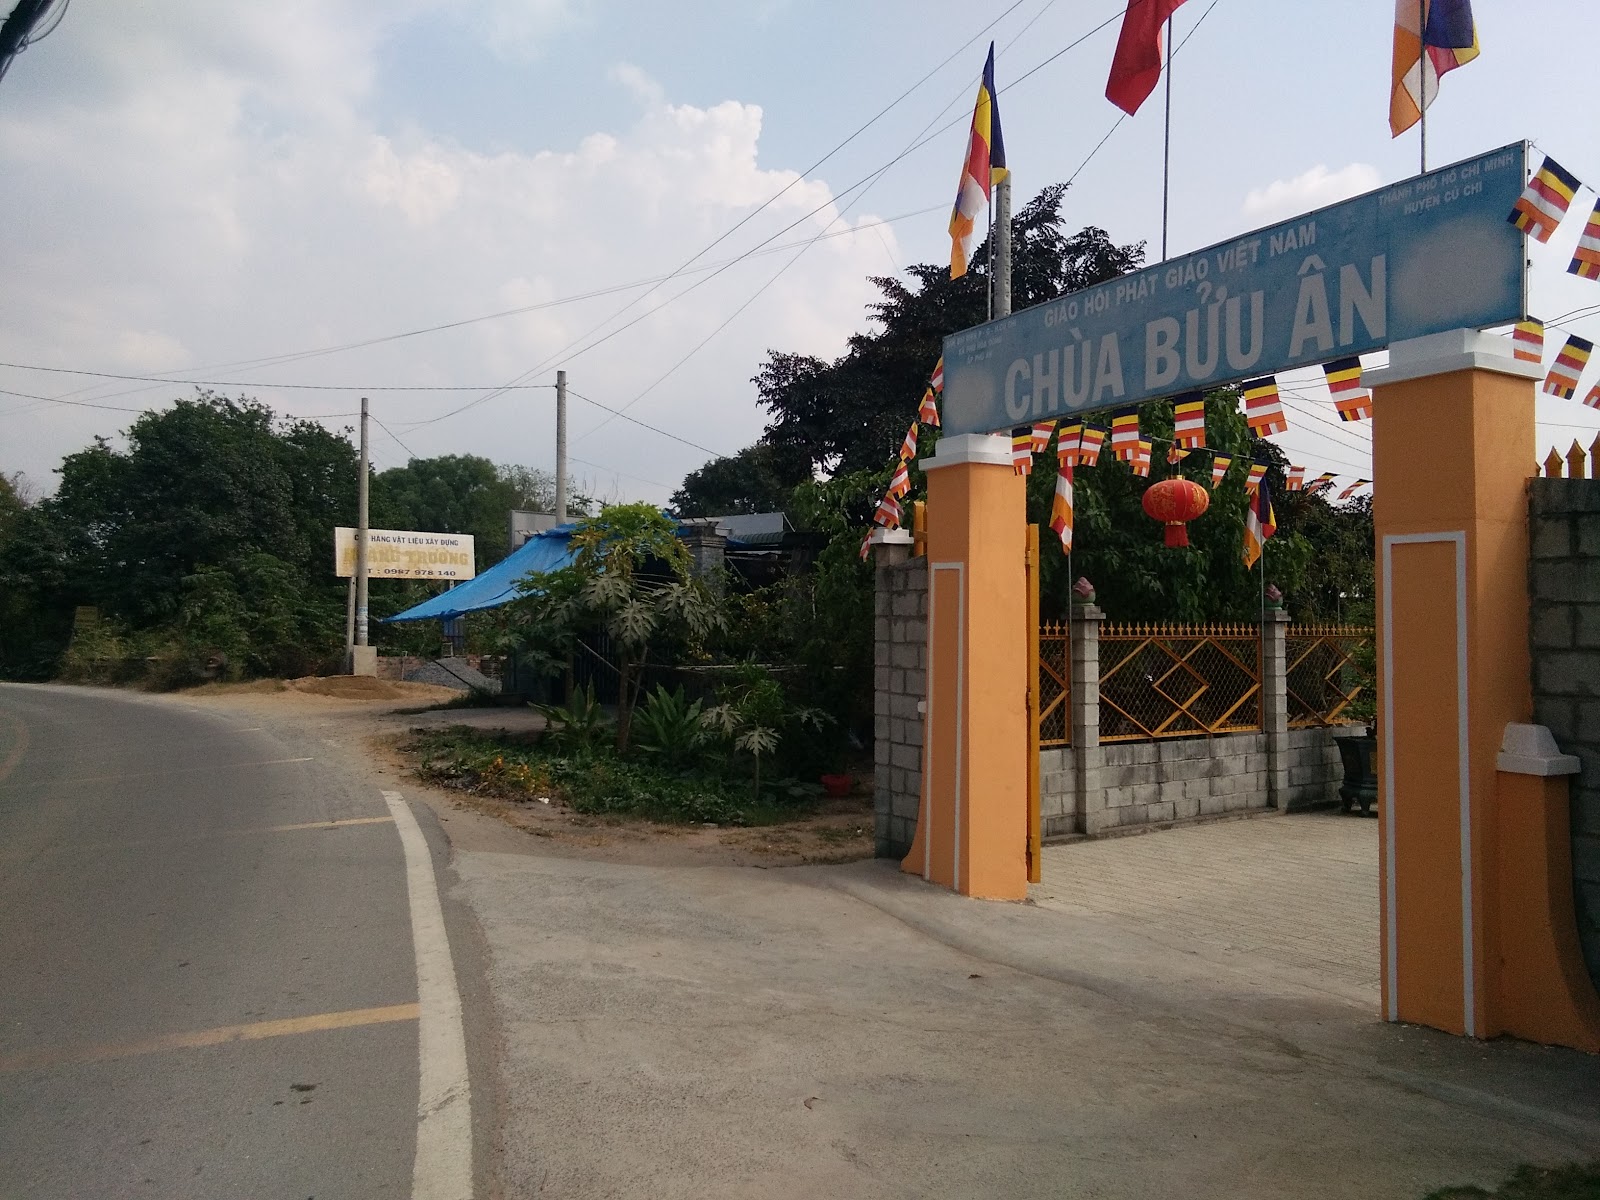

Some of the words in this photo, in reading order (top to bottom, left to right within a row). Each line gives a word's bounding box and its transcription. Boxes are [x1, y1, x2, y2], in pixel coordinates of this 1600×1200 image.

[1378, 186, 1412, 206] THÀNH
[1416, 175, 1438, 195] PHỐ
[1485, 153, 1515, 172] MINH
[1404, 194, 1441, 217] HUYỆN
[1463, 180, 1483, 197] CHI
[1044, 300, 1078, 328] GIÁO
[1084, 292, 1110, 316] HỘI
[1116, 273, 1159, 306] PHẬT
[1165, 257, 1209, 289] GIÁO
[1217, 237, 1262, 274] VIỆT
[1269, 221, 1317, 258] NAM
[1004, 326, 1125, 421] CHÙA
[1144, 281, 1265, 391] BỬU
[1288, 253, 1388, 359] ÂN
